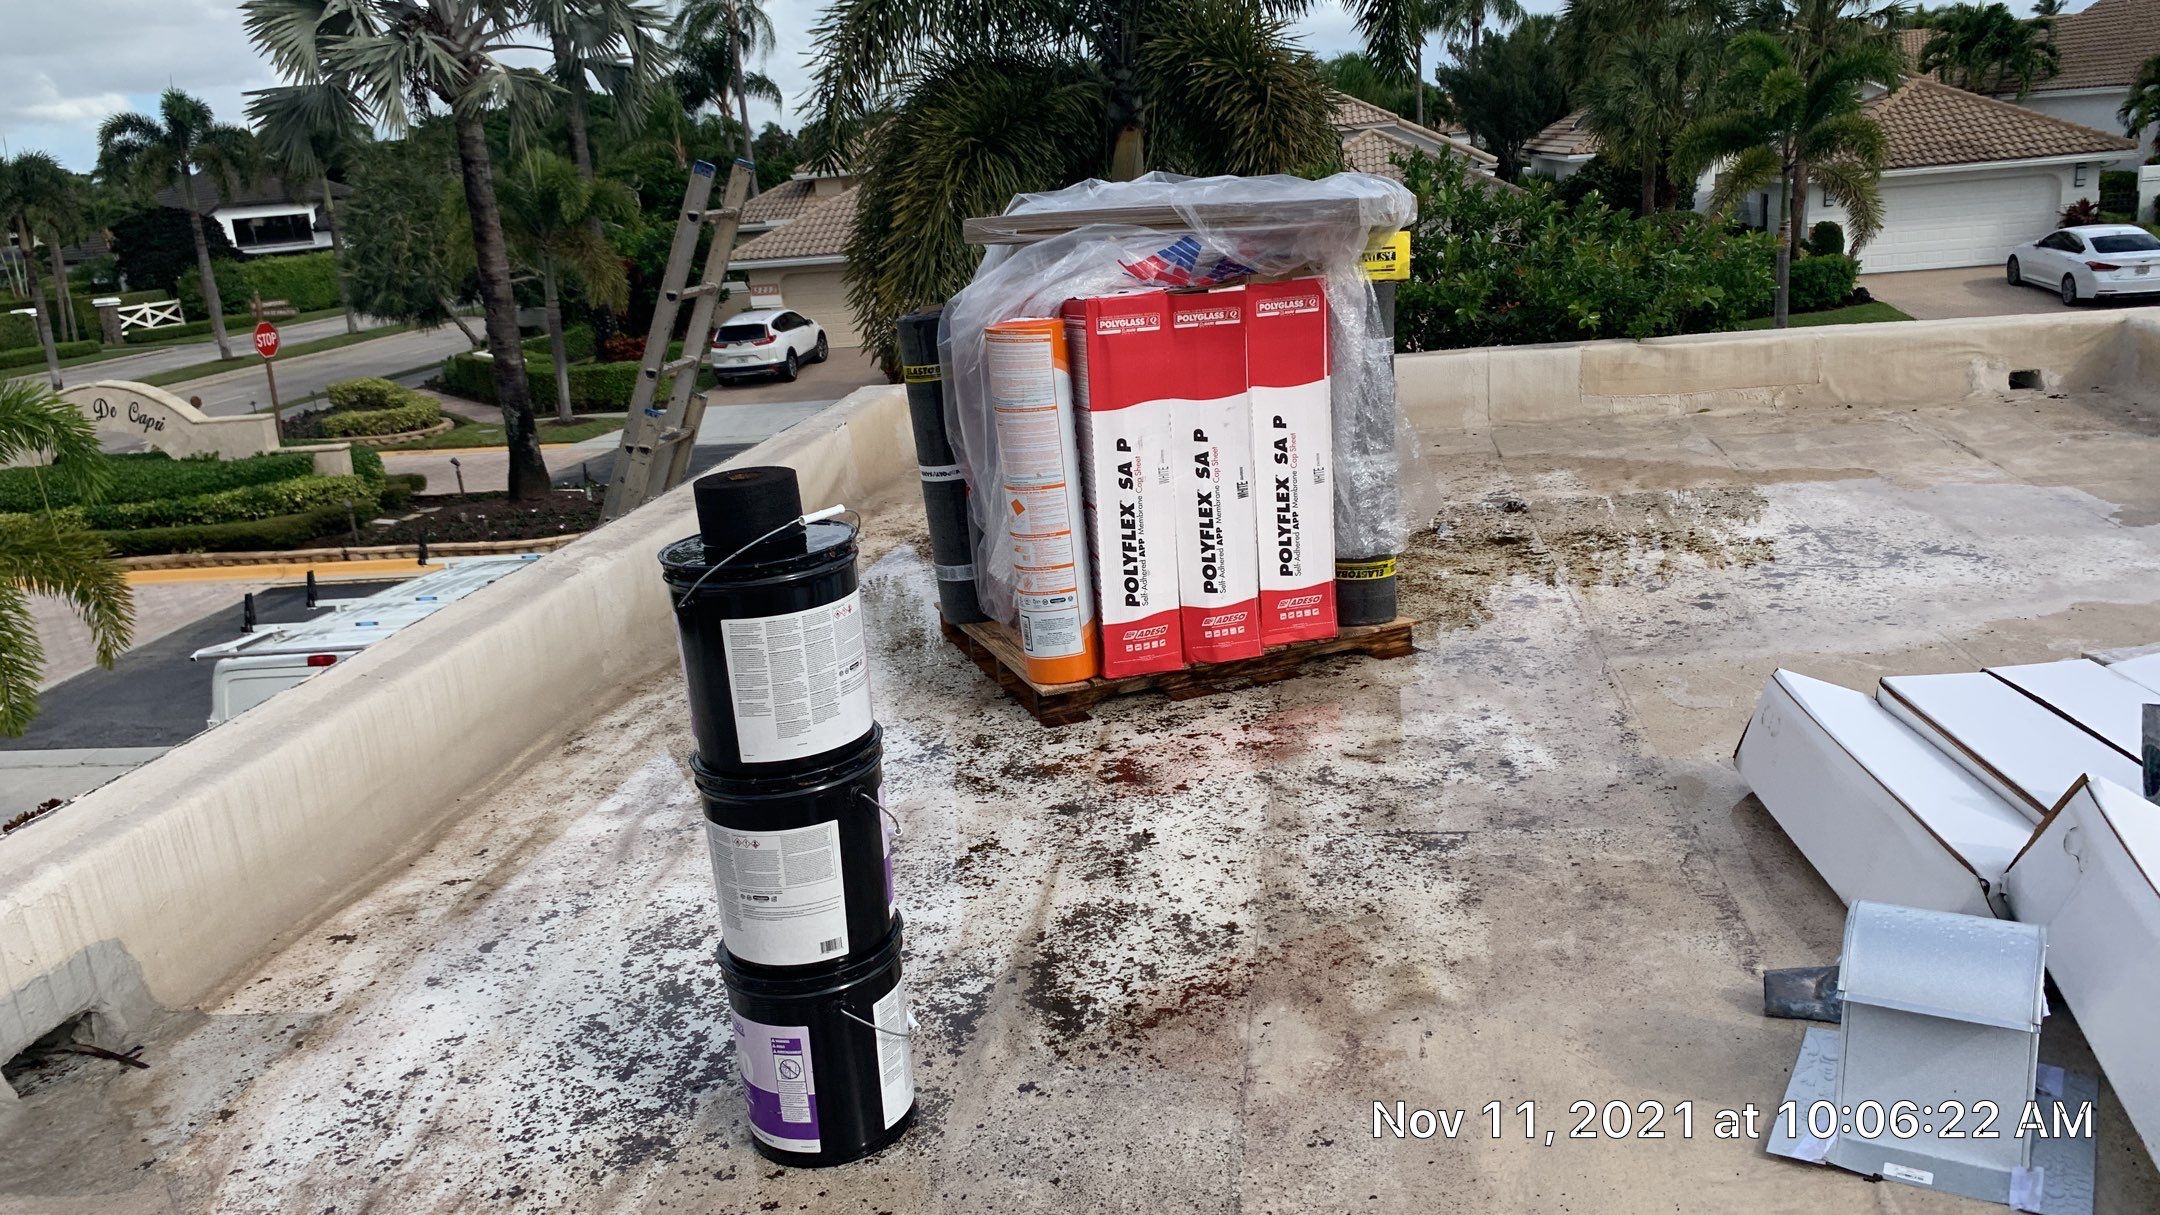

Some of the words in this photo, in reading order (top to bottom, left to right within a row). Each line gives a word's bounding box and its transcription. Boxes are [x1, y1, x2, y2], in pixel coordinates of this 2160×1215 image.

[1259, 300, 1304, 311] POLYGLASS
[1099, 318, 1145, 329] POLYGLASS
[1176, 311, 1224, 323] POLYGLASS
[257, 332, 276, 348] STOP
[93, 398, 116, 421] De
[129, 402, 165, 433] Capri
[1272, 415, 1287, 429] P
[1116, 438, 1132, 452] P
[1193, 428, 1209, 442] P
[1288, 432, 1296, 452] Sheet
[1211, 446, 1220, 467] Sheet
[1274, 437, 1289, 465] SA
[1289, 453, 1297, 469] Cap
[1133, 456, 1142, 476] Sheet
[1194, 451, 1211, 479] SA
[1118, 461, 1133, 490] SA
[1135, 477, 1144, 494] Cap
[1212, 467, 1221, 484] Cap
[1313, 466, 1325, 485] WHITE
[1236, 481, 1249, 500] WHITE
[1214, 485, 1222, 524] Membrane
[1137, 496, 1145, 535] Membrane
[1215, 526, 1223, 546] APP
[1275, 475, 1293, 577] POLYFLEX
[1138, 538, 1146, 558] APP
[1197, 490, 1218, 594] POLYFLEX
[1119, 501, 1140, 607] POLYFLEX
[1294, 531, 1302, 576] Self-Adhered
[1219, 547, 1227, 594] Self-Adhered
[1140, 559, 1149, 607] Self-Adhered
[1290, 596, 1320, 606] ADESO
[1216, 613, 1245, 624] ADESO
[1137, 626, 1167, 638] ADESO
